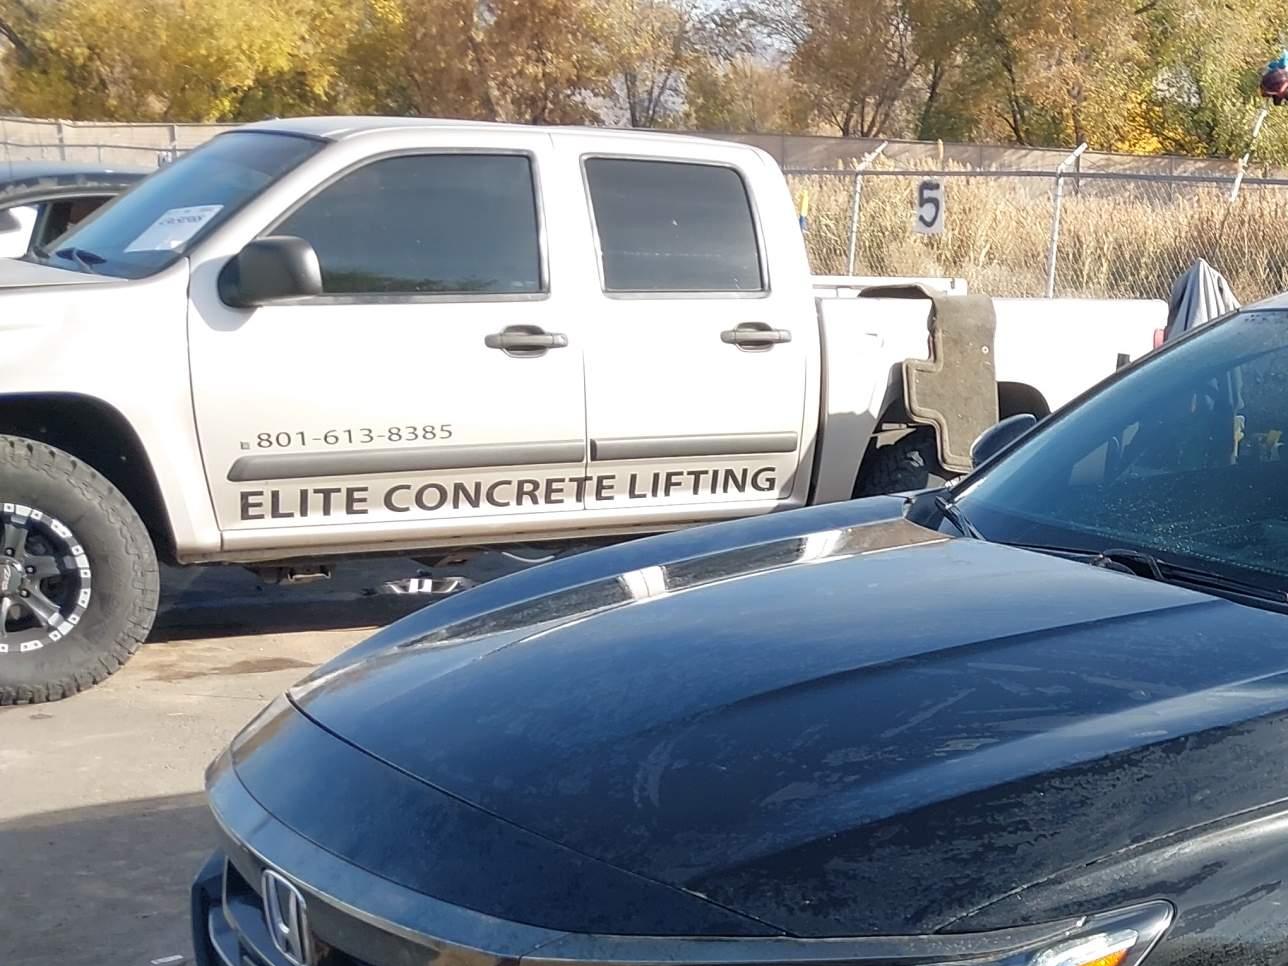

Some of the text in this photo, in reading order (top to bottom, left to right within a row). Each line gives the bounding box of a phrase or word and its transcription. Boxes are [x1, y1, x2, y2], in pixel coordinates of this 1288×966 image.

[919, 181, 940, 227] 5
[257, 423, 453, 448] 801-613-8385
[240, 467, 776, 520] ELITE CONCRETE LIFTING
